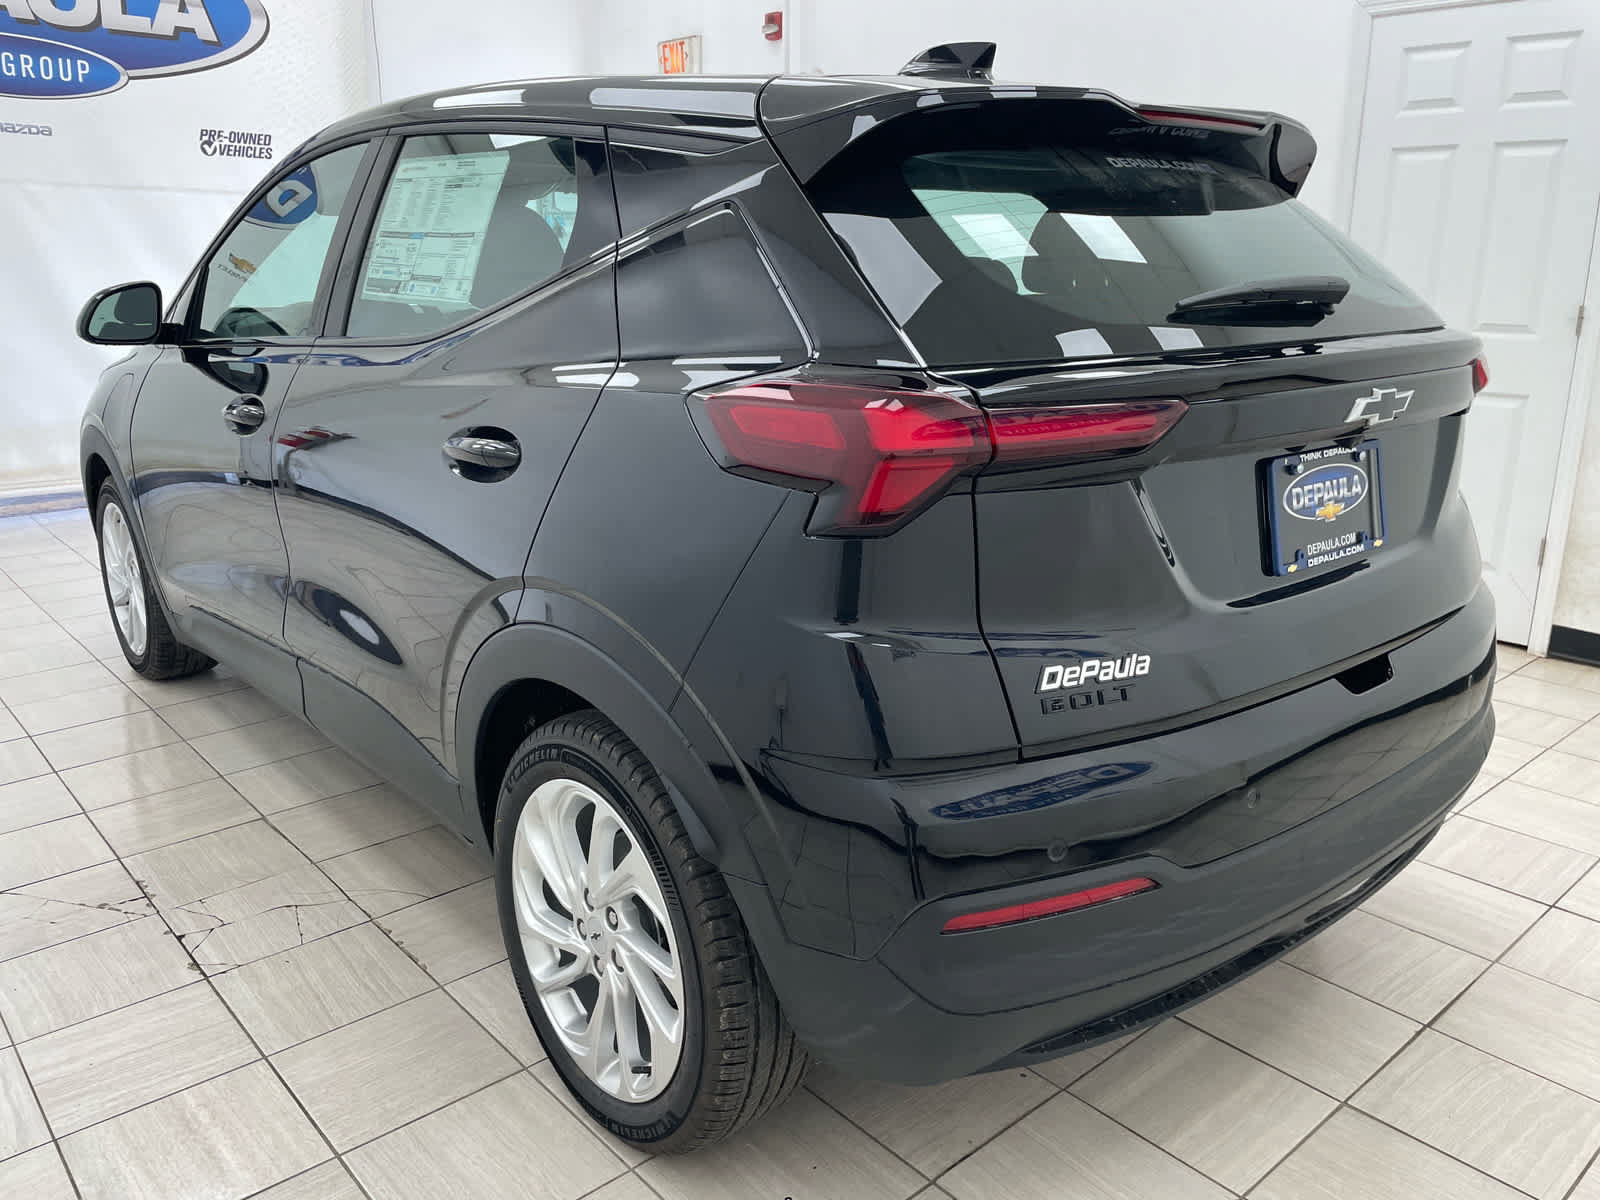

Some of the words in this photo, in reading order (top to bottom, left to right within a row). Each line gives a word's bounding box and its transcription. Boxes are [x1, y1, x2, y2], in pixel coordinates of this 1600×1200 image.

[1, 51, 91, 83] GROUP
[662, 41, 686, 74] EXIT
[200, 128, 272, 146] PRE-OWNED
[218, 143, 273, 160] VEHICLES
[1300, 451, 1322, 462] THINK
[1291, 474, 1362, 510] DEPAULA
[1307, 531, 1356, 556] DEPAULA.COM
[1307, 543, 1365, 567] DEPAULA.COM
[1039, 653, 1151, 691] DePaula
[1040, 683, 1136, 715] BOLT
